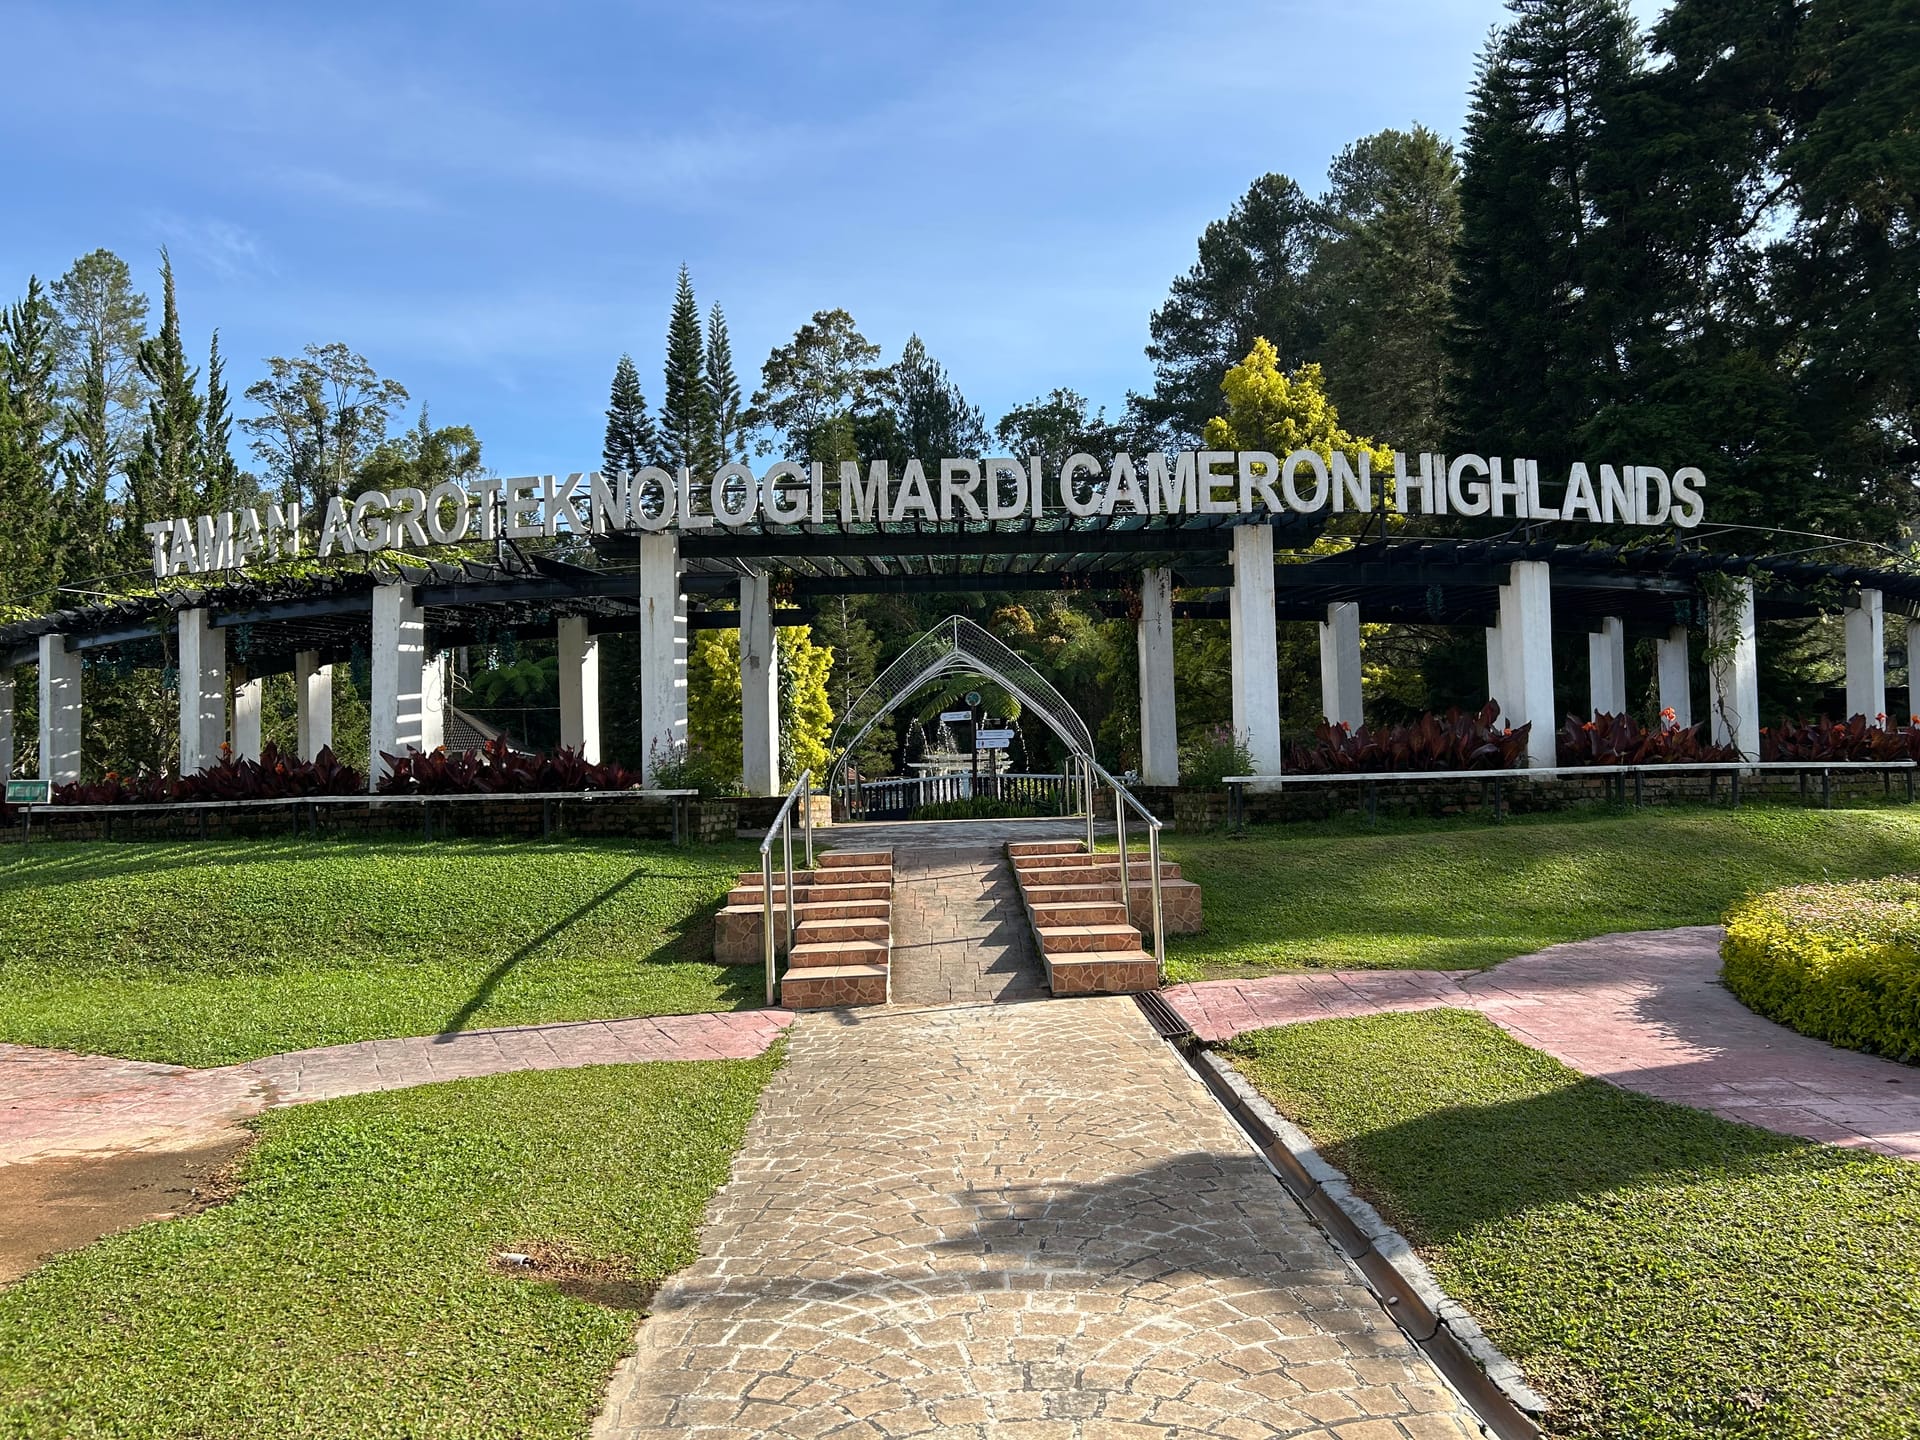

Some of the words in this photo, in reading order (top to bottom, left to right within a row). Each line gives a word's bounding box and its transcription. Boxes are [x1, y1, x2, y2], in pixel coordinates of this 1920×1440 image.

[144, 502, 299, 578] TAMAN
[318, 461, 824, 557] AGROTEKNOLOGI
[840, 455, 1042, 522] MARDI
[1060, 450, 1372, 517] CAMERON
[1394, 451, 1706, 528] HIGHLANDS
